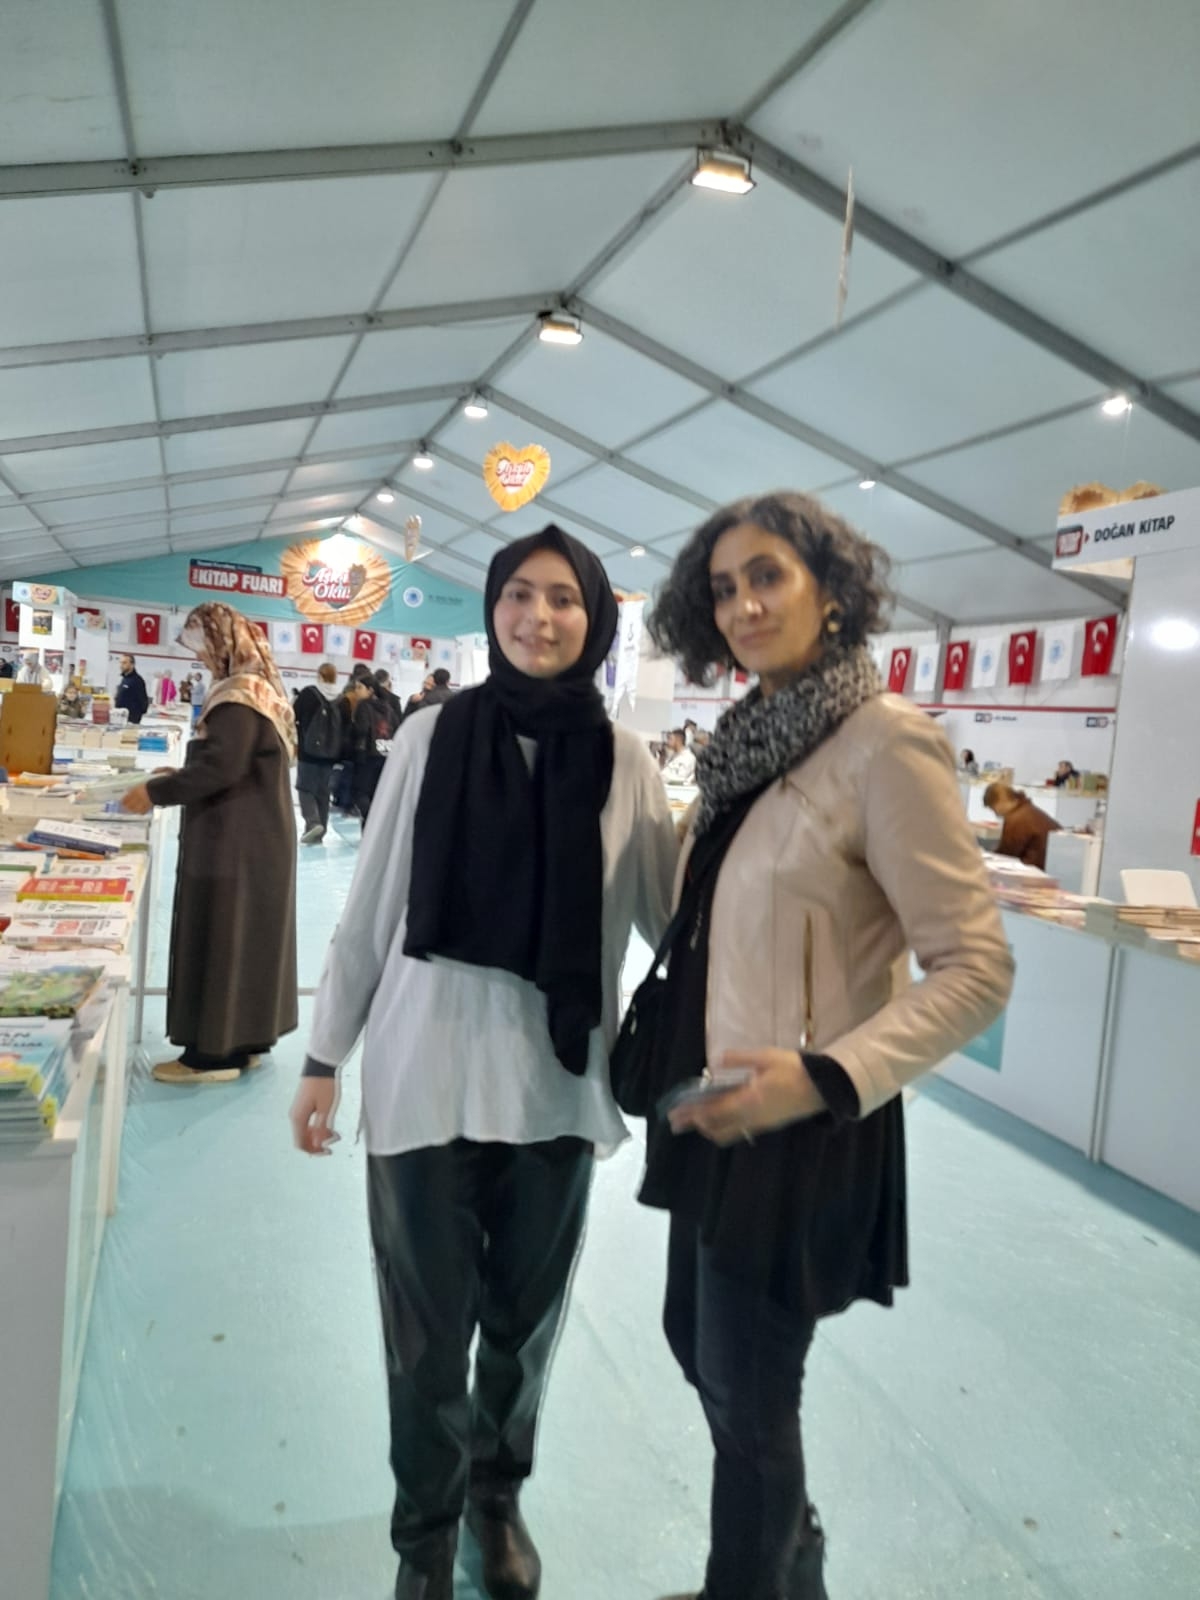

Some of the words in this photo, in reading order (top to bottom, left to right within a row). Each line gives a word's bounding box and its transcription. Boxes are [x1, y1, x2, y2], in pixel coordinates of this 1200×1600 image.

[1094, 521, 1135, 542] DOĞAN
[1139, 515, 1175, 534] KİTAP
[199, 569, 238, 588] KİTAP
[241, 573, 284, 594] FUARI
